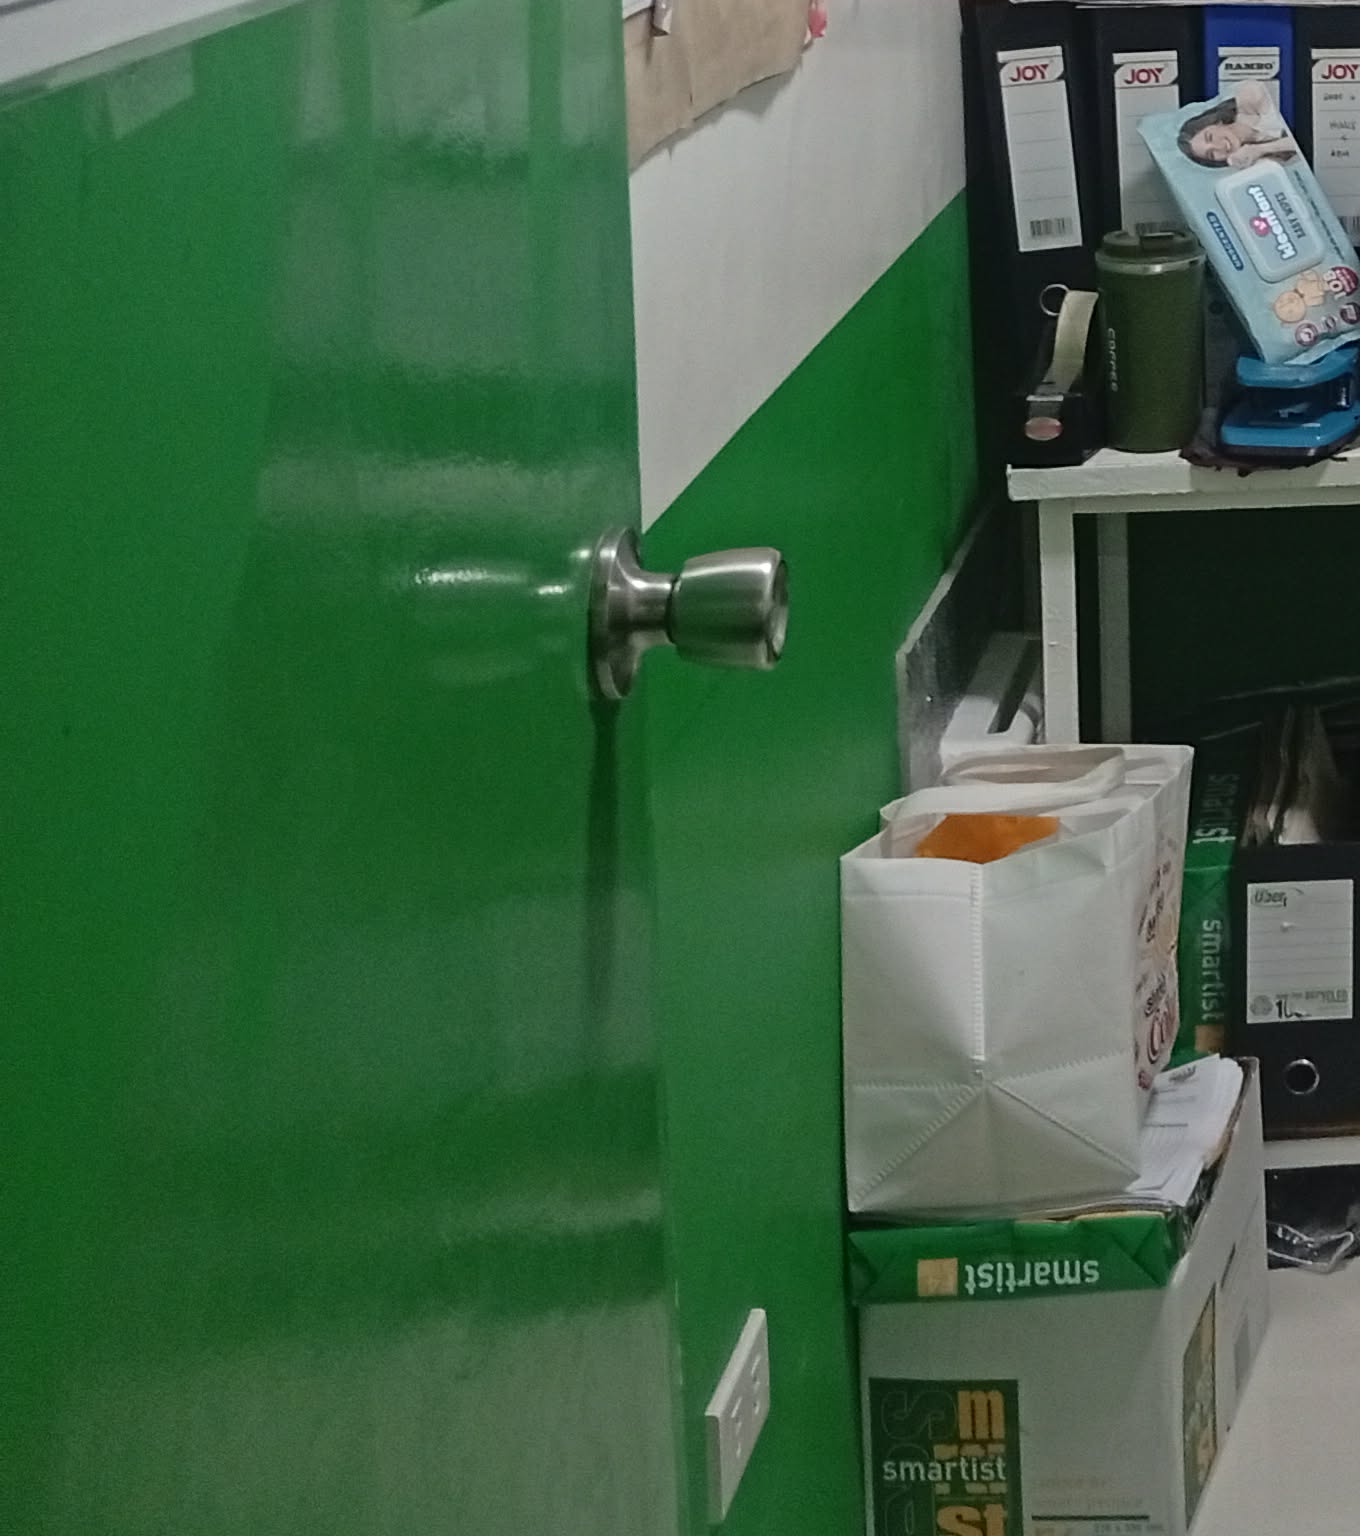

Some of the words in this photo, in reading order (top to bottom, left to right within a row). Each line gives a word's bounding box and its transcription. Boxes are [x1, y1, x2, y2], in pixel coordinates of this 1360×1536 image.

[1010, 63, 1050, 83] JOY
[1124, 67, 1166, 85] JOY
[1224, 62, 1274, 71] RAMBO
[1321, 64, 1360, 80] JOY
[1246, 184, 1299, 261] kleenfant
[1202, 919, 1225, 1021] smartist
[964, 1259, 1100, 1296] smartist
[882, 1456, 1007, 1482] smartist
